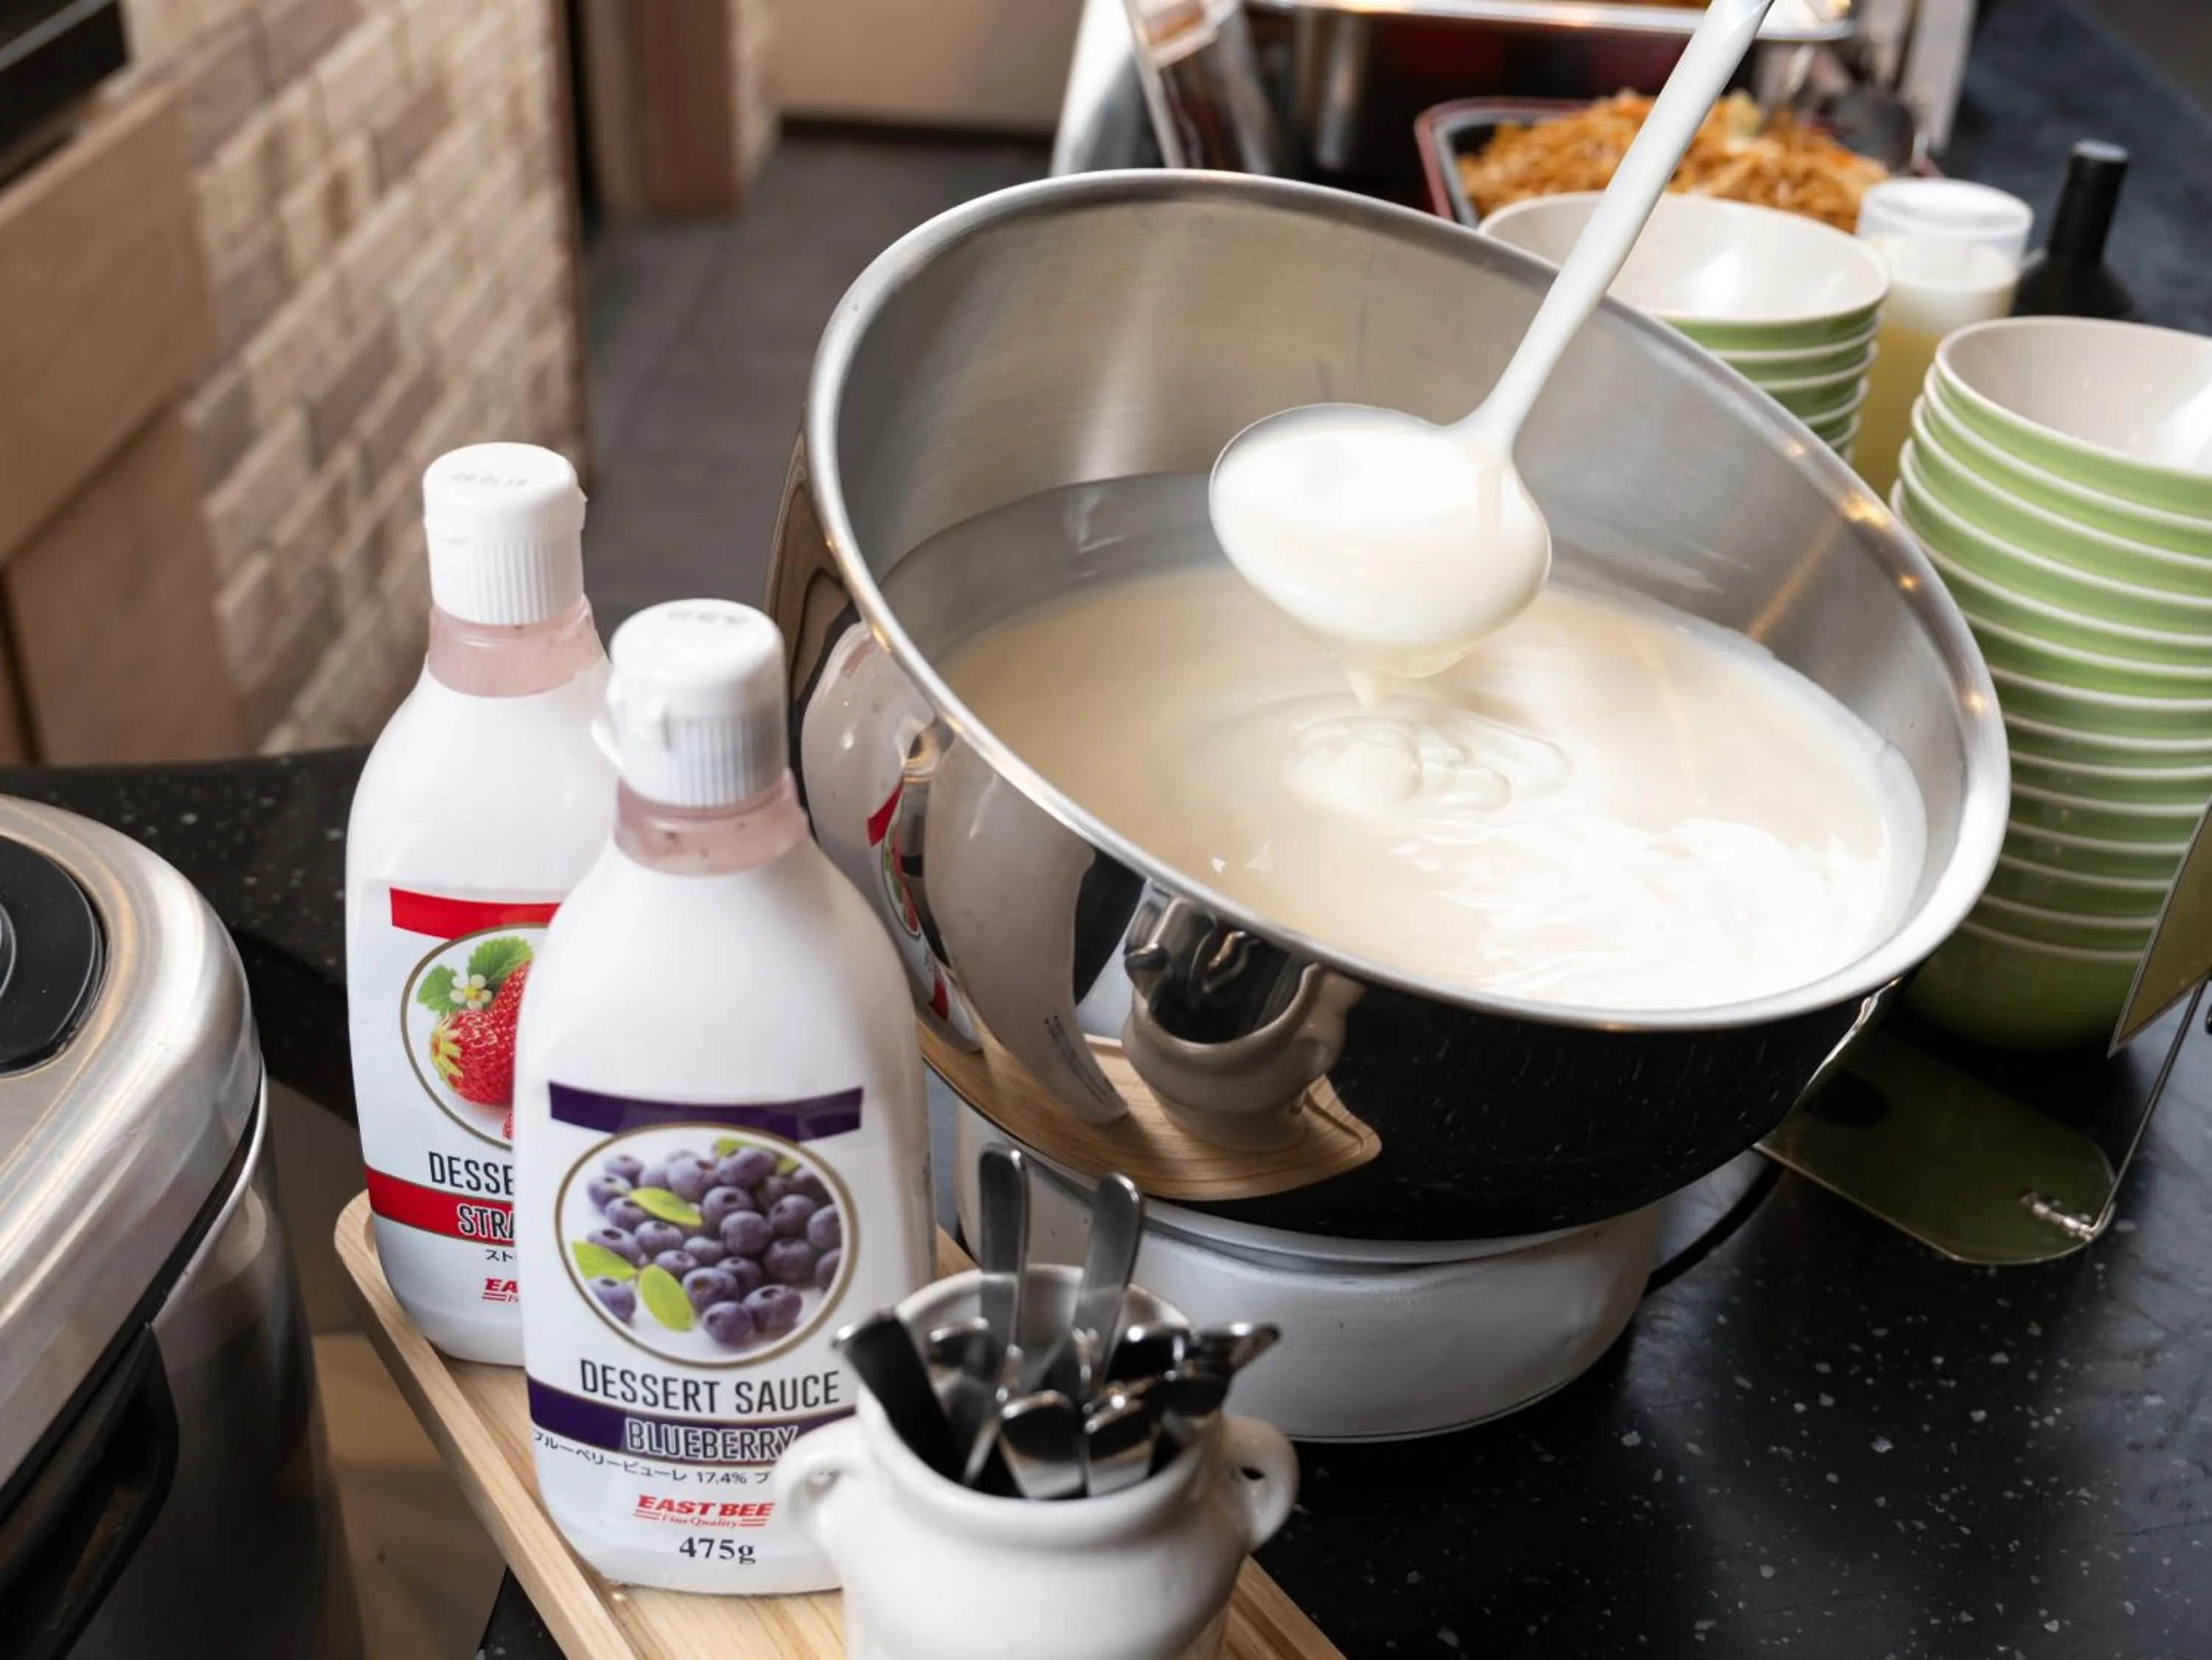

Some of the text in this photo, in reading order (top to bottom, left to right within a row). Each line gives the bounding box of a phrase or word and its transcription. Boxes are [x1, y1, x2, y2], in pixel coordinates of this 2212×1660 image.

[580, 1359, 840, 1415] DESSERT SAUCE
[625, 1417, 799, 1462] BLUEBERRY
[637, 1494, 775, 1517] EAST BEE
[678, 1536, 756, 1565] 475g
